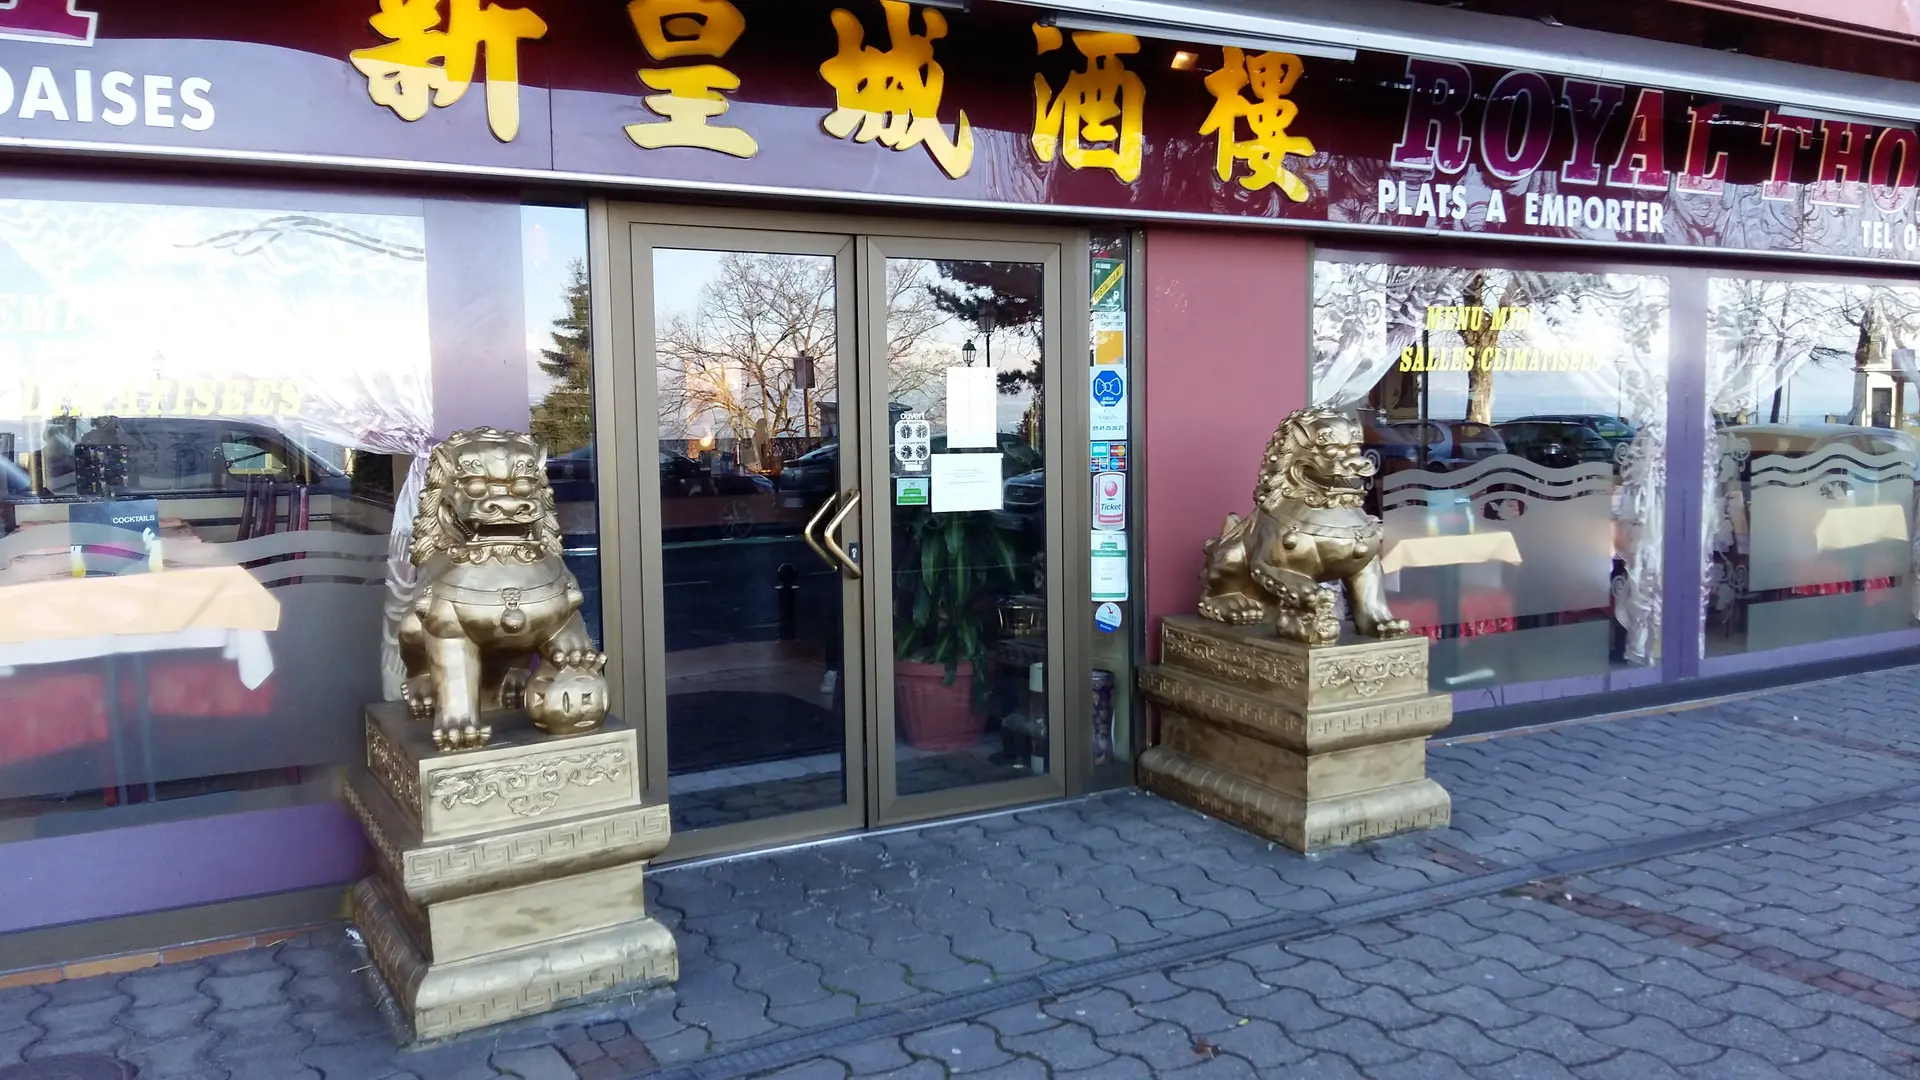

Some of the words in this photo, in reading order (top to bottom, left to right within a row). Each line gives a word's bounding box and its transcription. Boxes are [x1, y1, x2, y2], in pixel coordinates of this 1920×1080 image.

[1390, 54, 1729, 196] ROYAL
[1761, 110, 1920, 214] THO
[1378, 178, 1467, 220] PLATS
[1485, 189, 1507, 223] A
[1524, 191, 1664, 234] EMPORTER
[1861, 220, 1893, 250] TEL
[1903, 223, 1920, 251] 0
[1426, 306, 1485, 331] MENU
[1490, 306, 1536, 331] MIDI
[1399, 346, 1476, 372] SALLES
[900, 412, 925, 420] ouvert
[112, 514, 155, 524] COCKTAILS
[1100, 503, 1122, 511] Ticket
